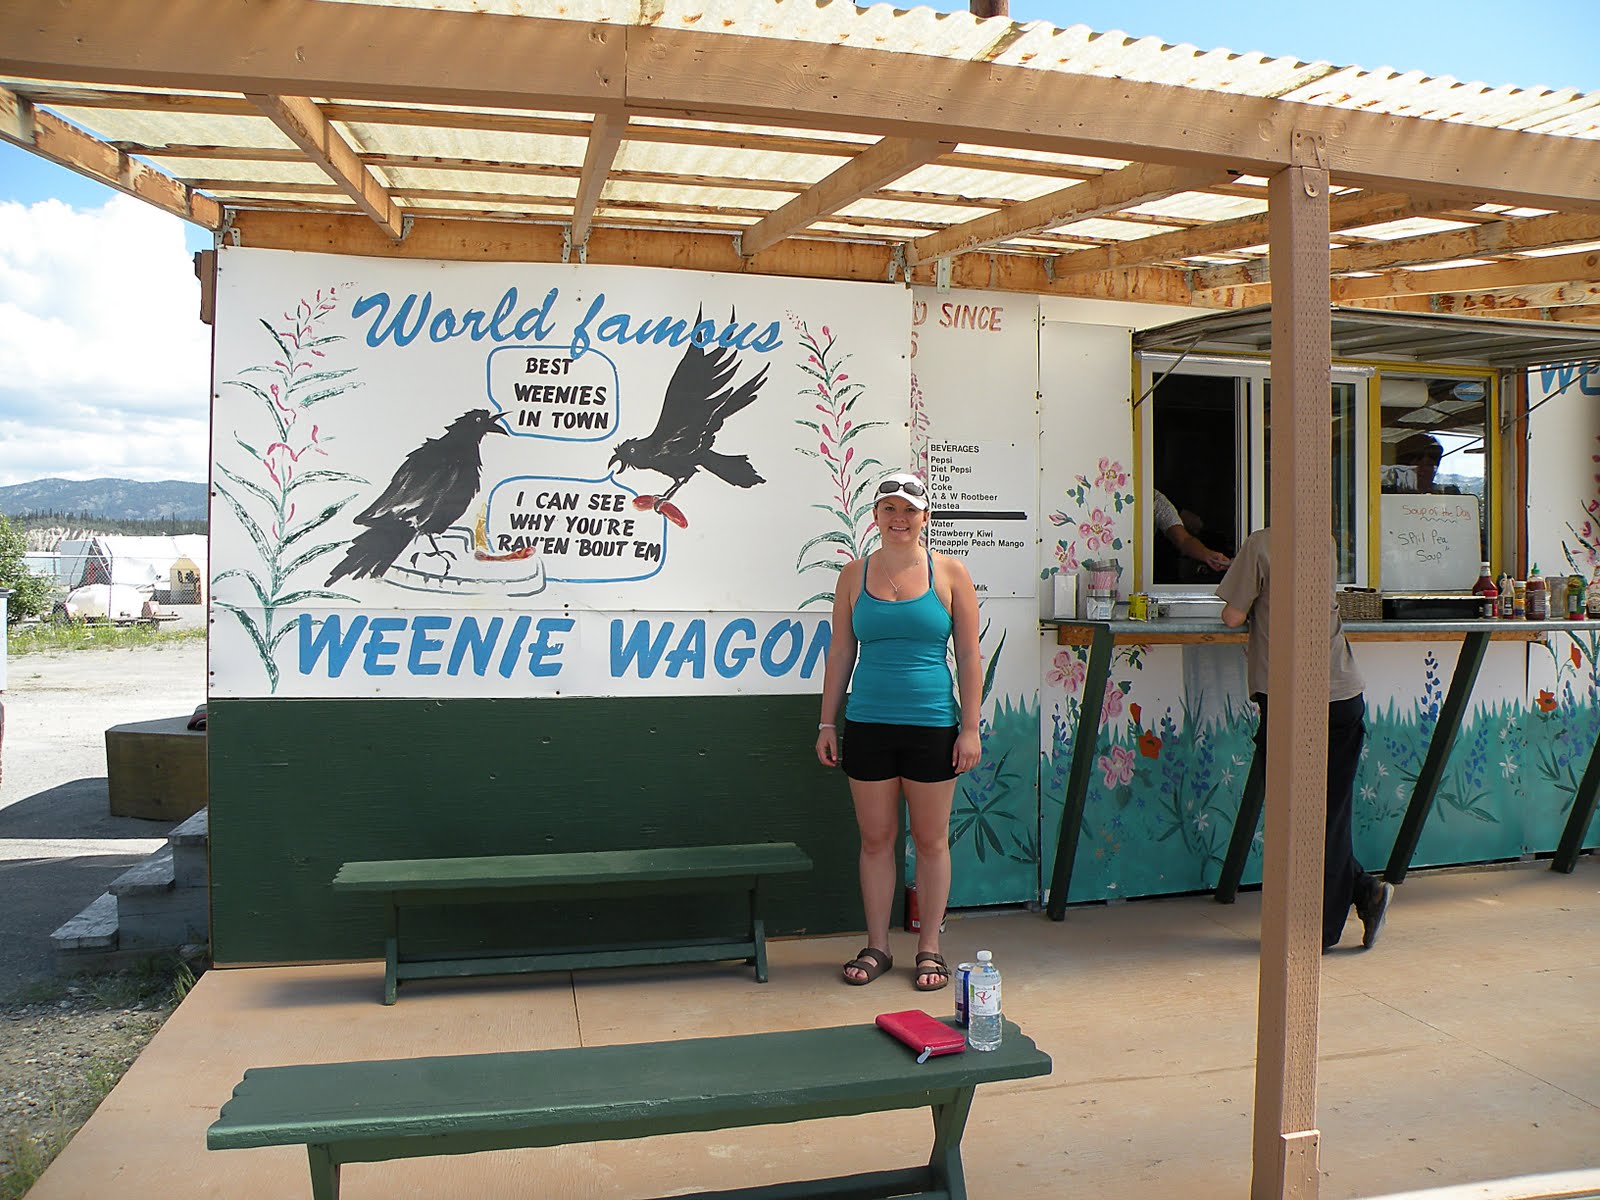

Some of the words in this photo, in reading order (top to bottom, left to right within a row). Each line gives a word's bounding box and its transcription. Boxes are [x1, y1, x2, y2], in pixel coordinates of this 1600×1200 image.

[351, 286, 559, 347] World
[570, 293, 783, 359] famous
[939, 303, 1003, 331] SINCE
[525, 358, 574, 375] BEST
[514, 383, 607, 405] WEENIES
[518, 410, 541, 427] IN
[552, 412, 608, 429] TOWN
[930, 444, 979, 453] BEVERAGES
[950, 466, 972, 474] Pepsi
[516, 491, 524, 506] I
[536, 492, 579, 511] CAN
[588, 494, 626, 512] SEE
[510, 513, 556, 532] WHY
[566, 516, 635, 537] YOU'RE
[930, 530, 974, 538] Strawberry
[930, 539, 968, 547] Pineapple
[999, 540, 1024, 548] Mango
[299, 613, 576, 679] WEENIE
